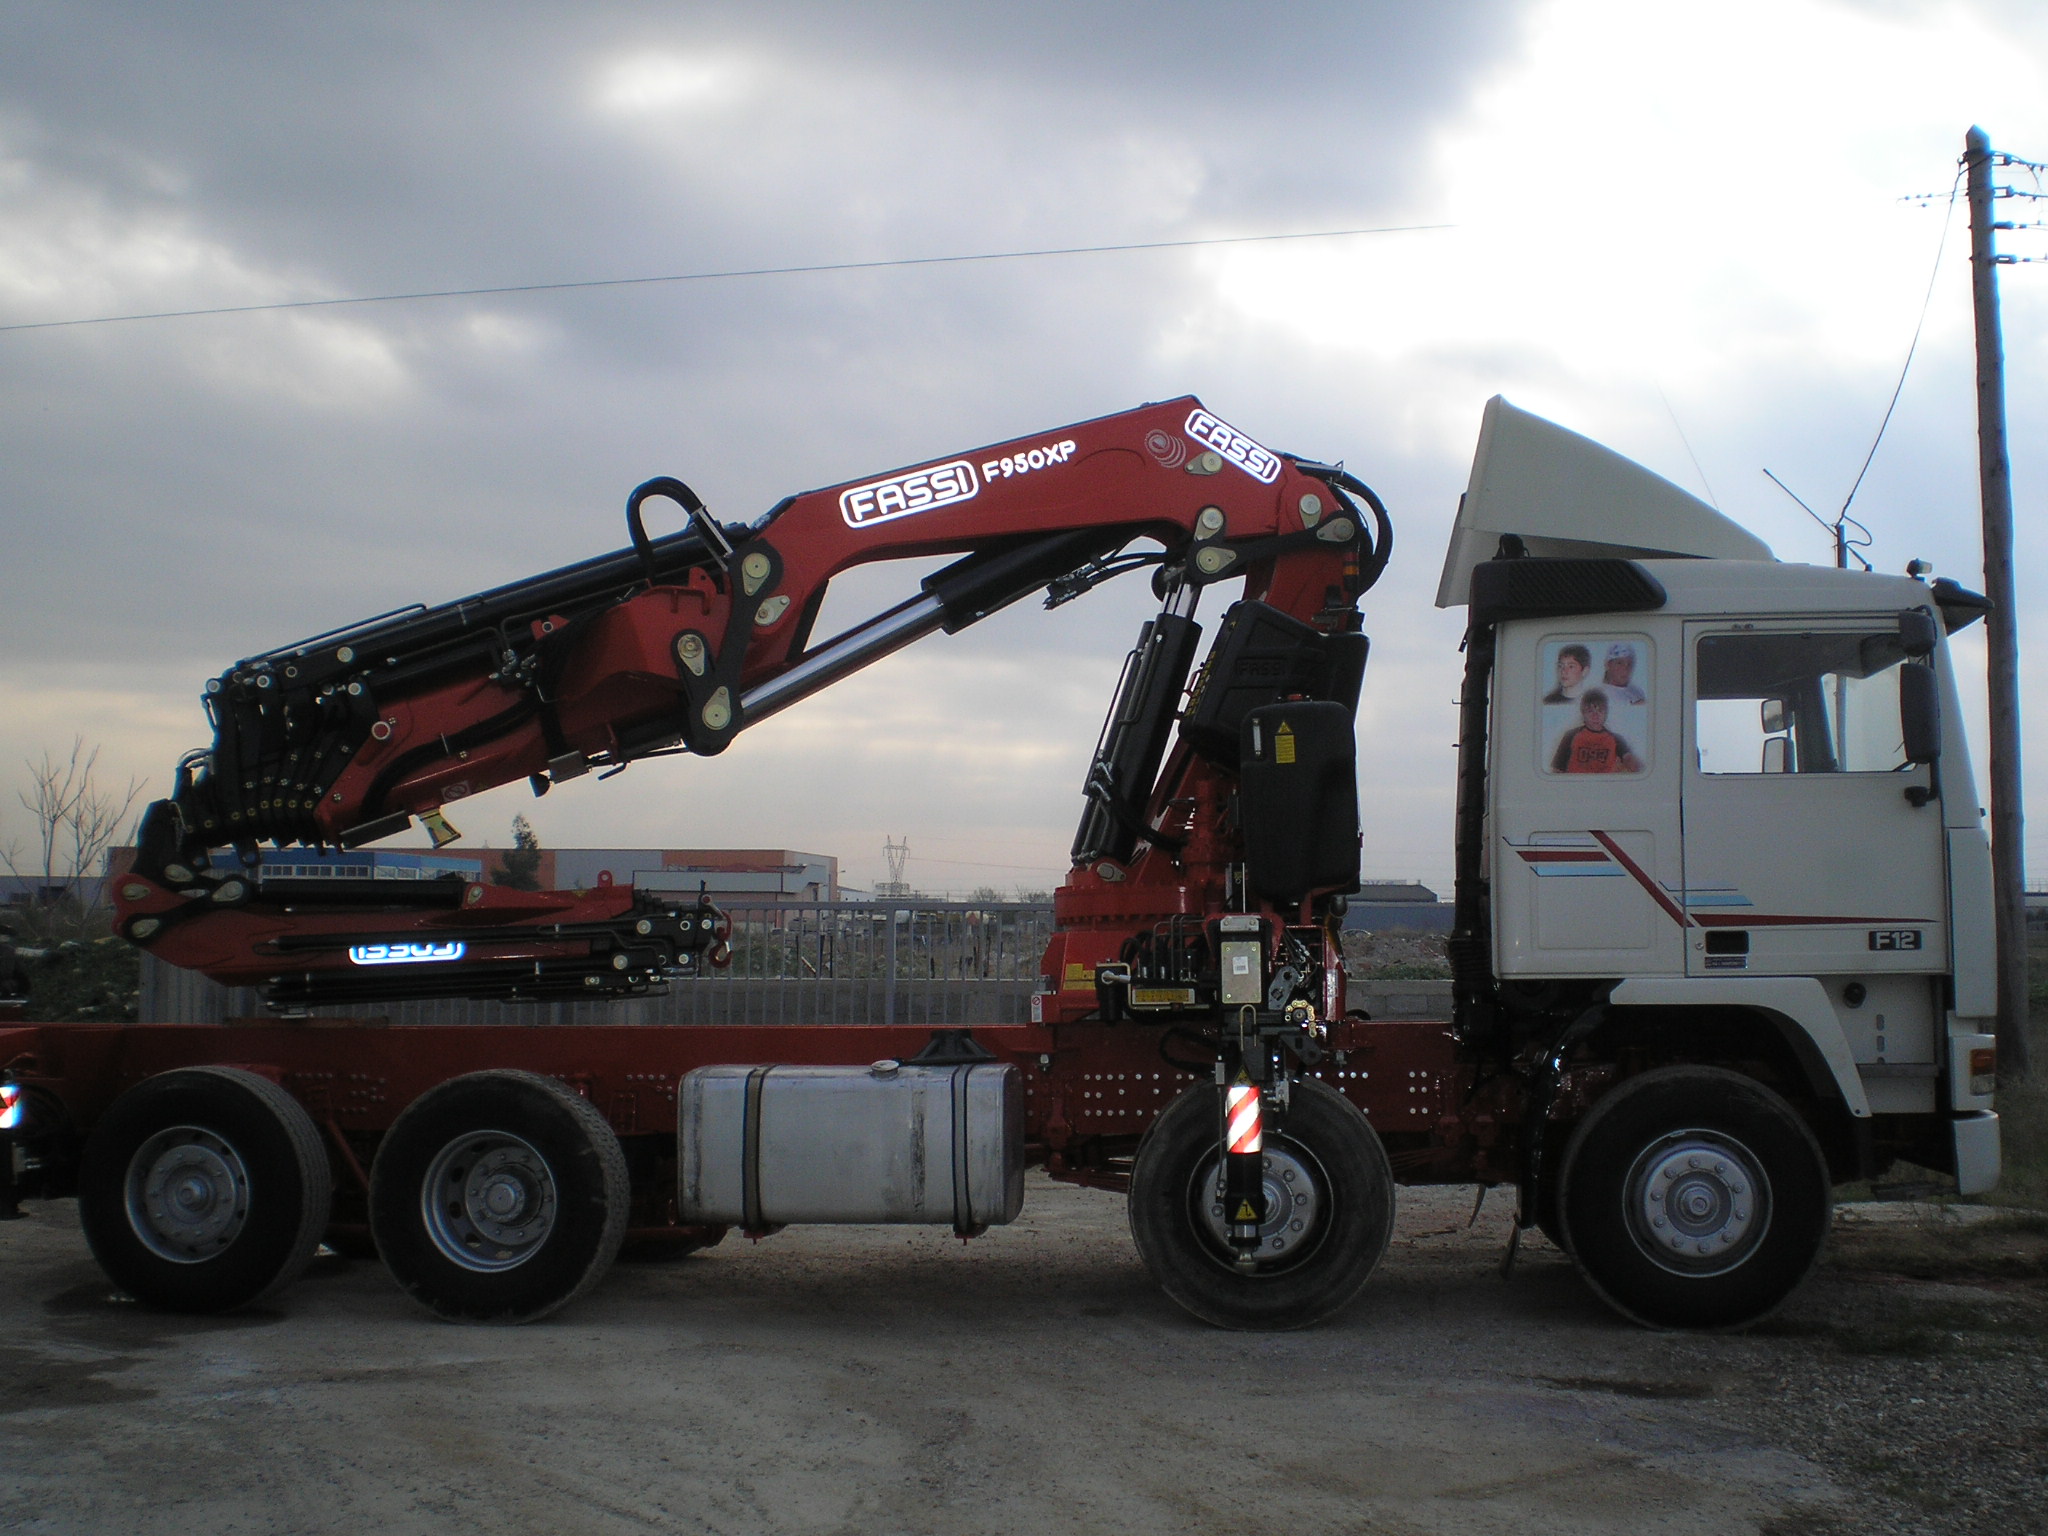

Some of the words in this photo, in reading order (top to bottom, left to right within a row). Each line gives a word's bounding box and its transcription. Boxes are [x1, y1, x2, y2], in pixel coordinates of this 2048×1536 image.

[1191, 414, 1275, 478] FASSI
[850, 467, 969, 521] FASSI
[982, 439, 1076, 482] F950XP
[1875, 931, 1915, 950] F12
